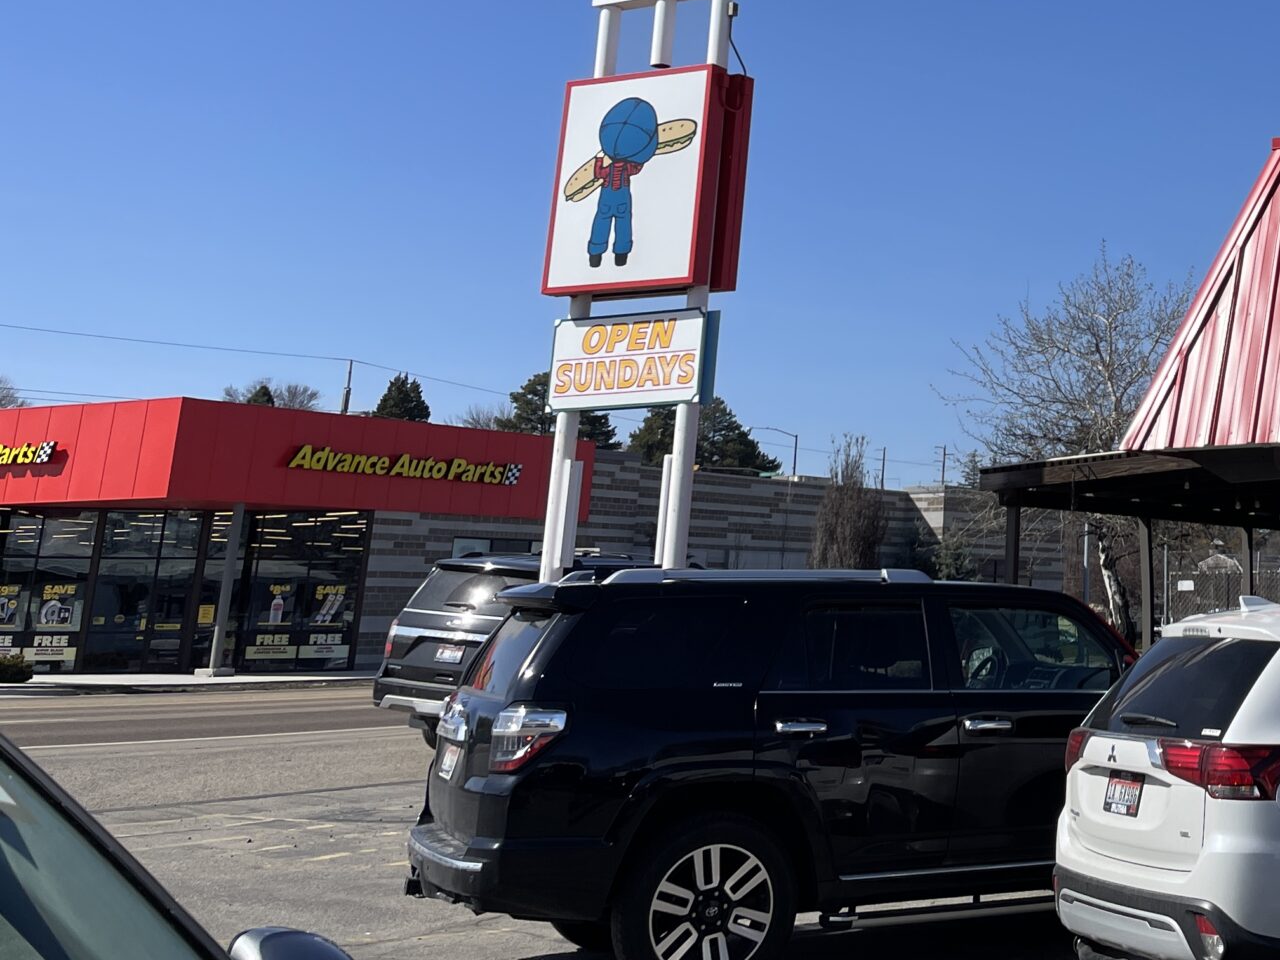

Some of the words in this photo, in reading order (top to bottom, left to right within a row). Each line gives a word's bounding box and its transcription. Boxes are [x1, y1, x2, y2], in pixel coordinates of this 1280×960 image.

[582, 318, 677, 355] OPEN
[554, 353, 696, 394] SUNDAYS
[0, 442, 36, 465] arts
[288, 444, 390, 475] Advance
[389, 453, 447, 480] Auto
[447, 458, 504, 484] Parts
[43, 584, 76, 594] SAVE
[316, 585, 346, 595] SAVE
[33, 635, 69, 647] FREE
[256, 634, 290, 646] FREE
[309, 633, 343, 645] FREE
